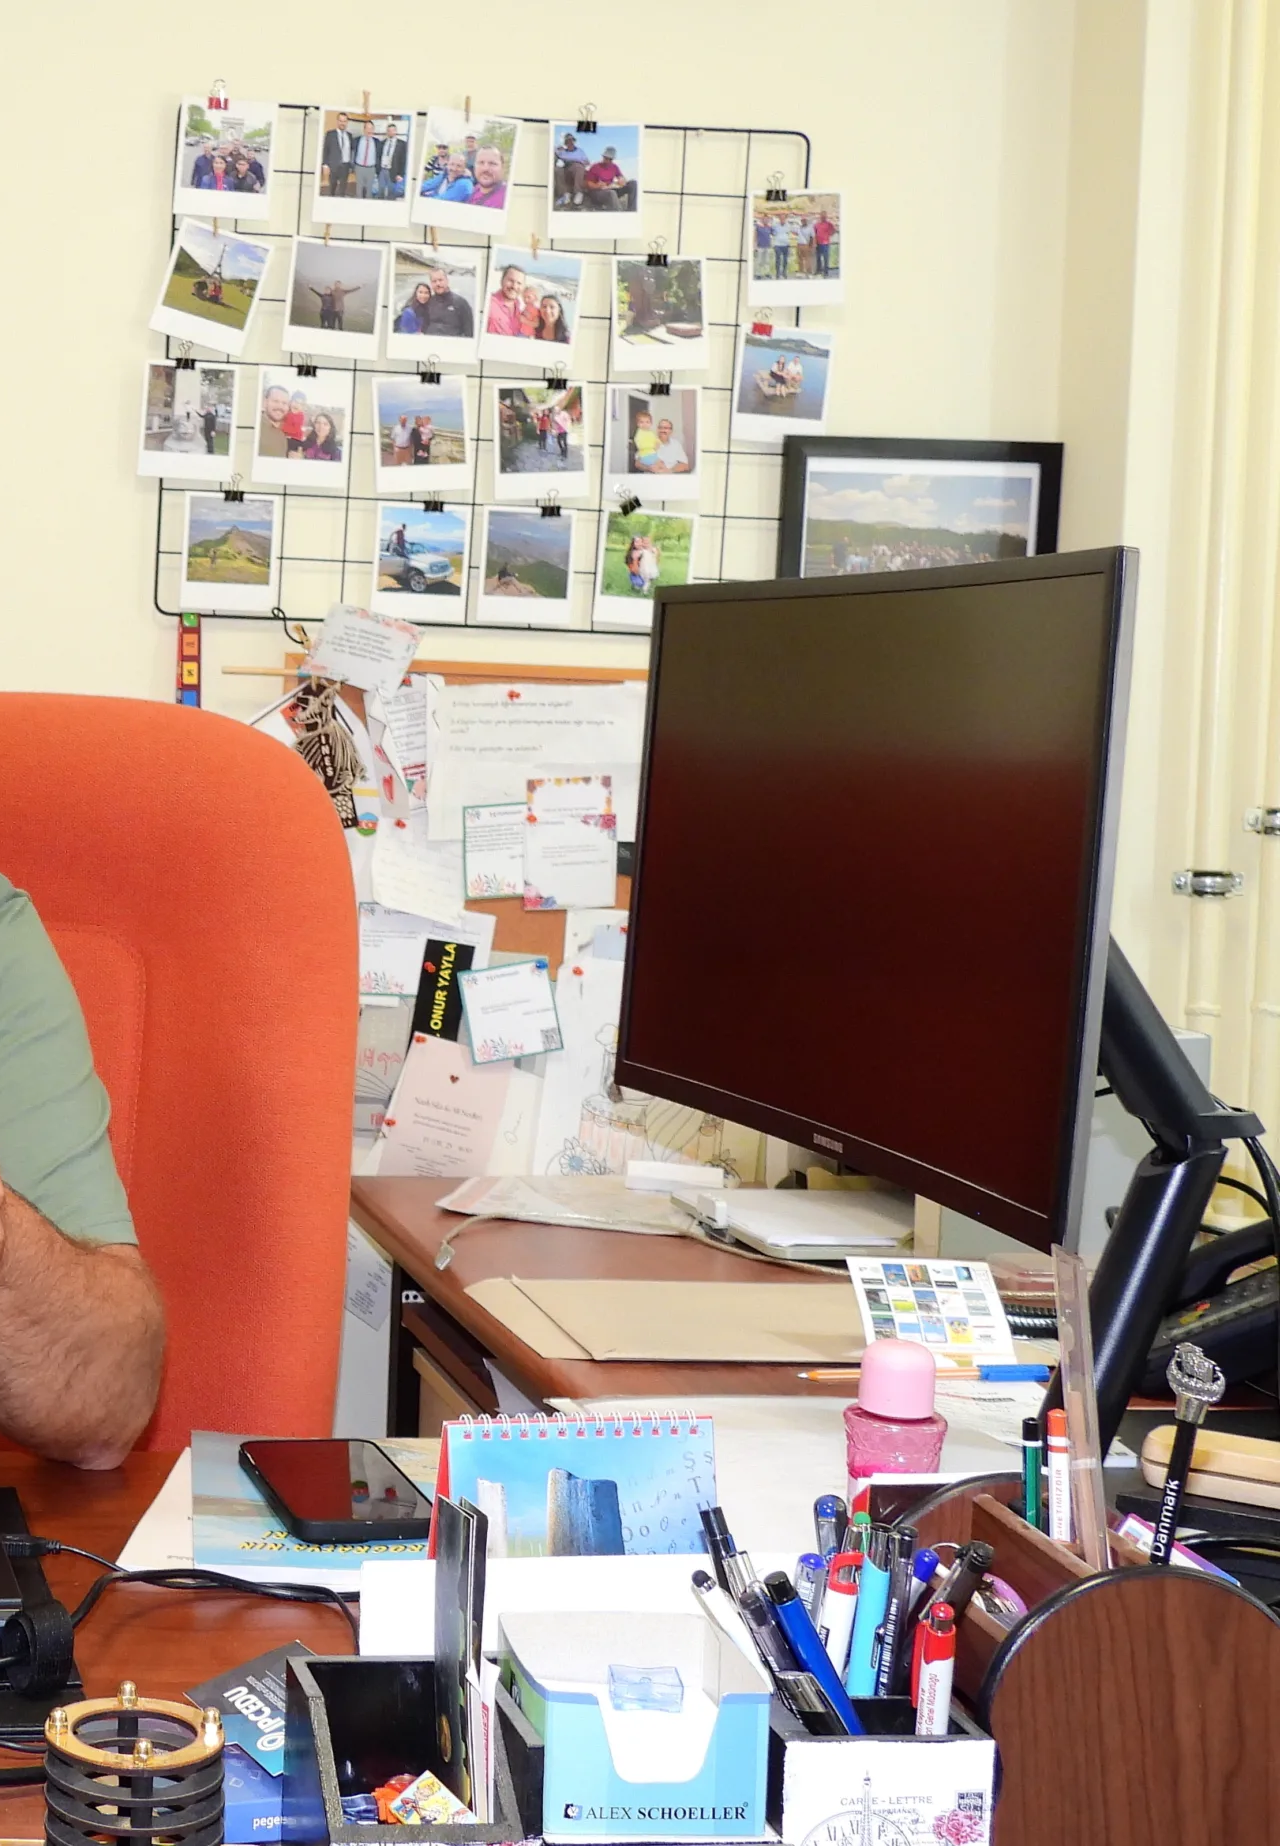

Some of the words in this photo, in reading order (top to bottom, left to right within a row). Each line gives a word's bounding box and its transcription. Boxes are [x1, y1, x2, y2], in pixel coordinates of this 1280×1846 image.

[437, 942, 457, 988] YAYLA
[429, 989, 448, 1030] ONUR
[1150, 1478, 1180, 1557] Danmark
[239, 1541, 428, 1554] ROGRAFYA'NIN
[252, 1815, 283, 1831] pege
[585, 1806, 632, 1820] ALEX
